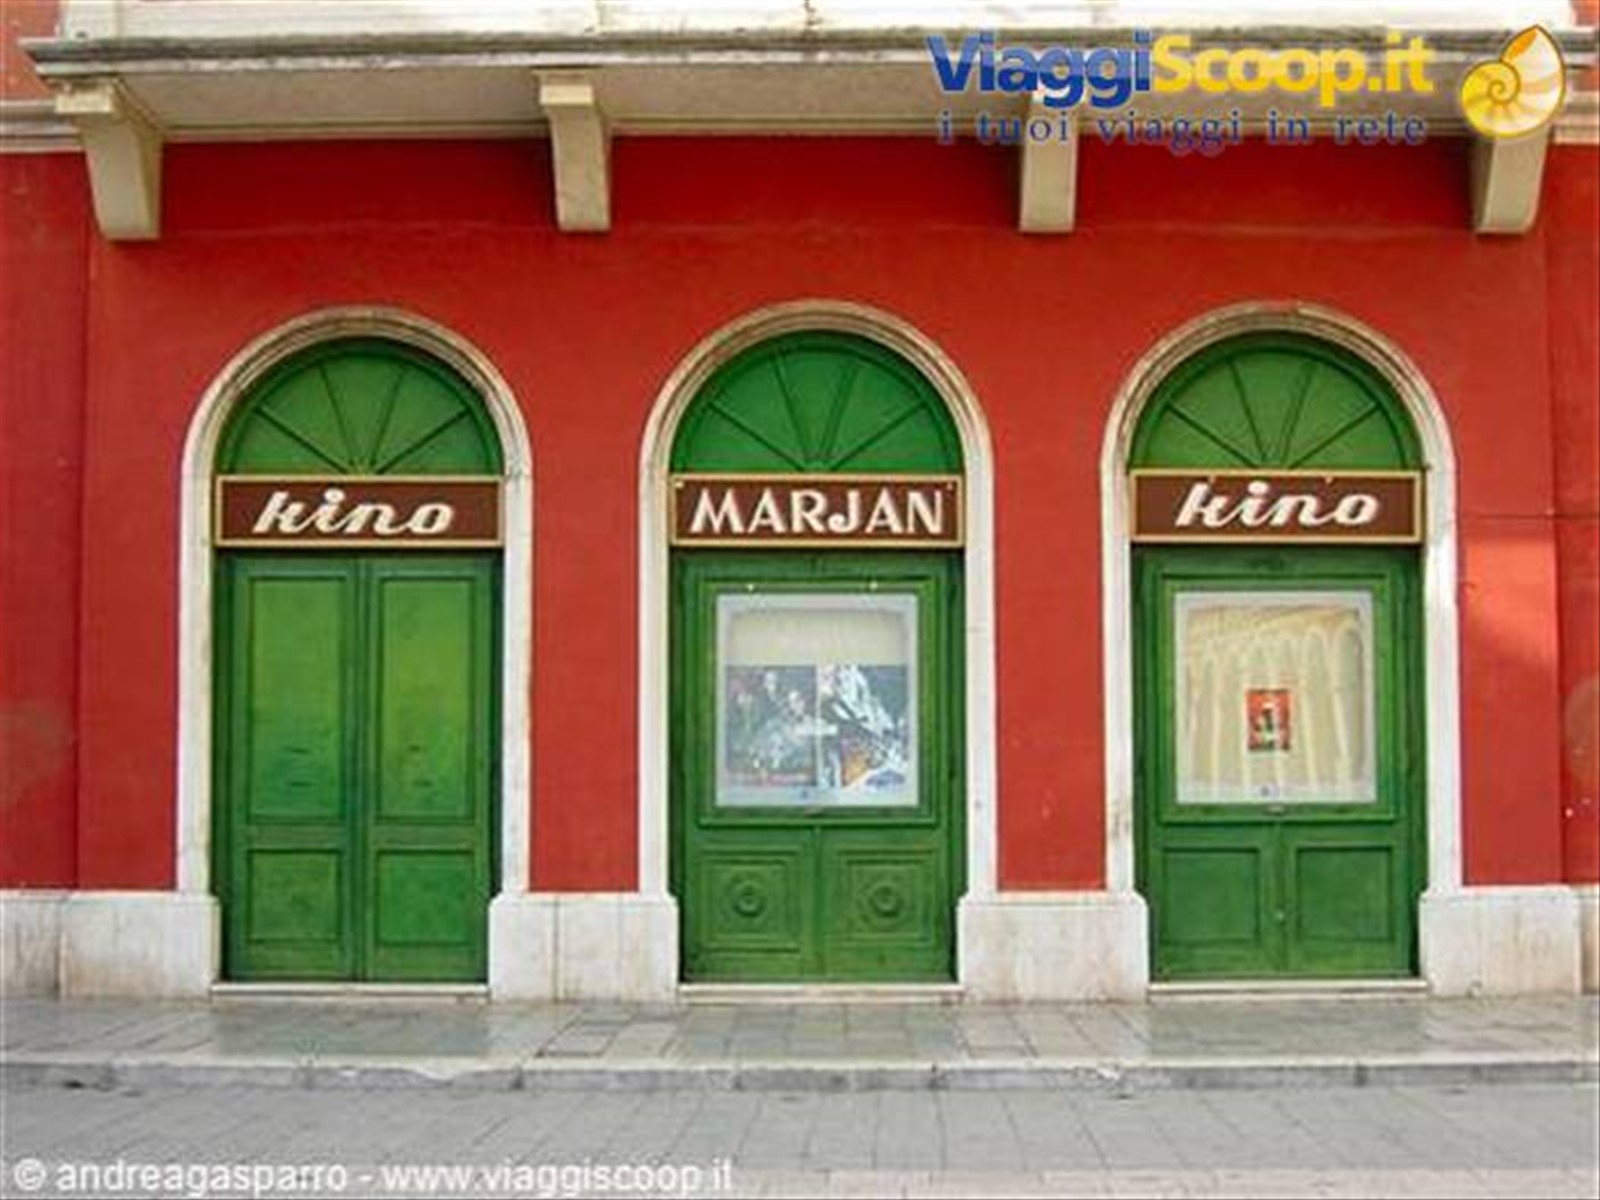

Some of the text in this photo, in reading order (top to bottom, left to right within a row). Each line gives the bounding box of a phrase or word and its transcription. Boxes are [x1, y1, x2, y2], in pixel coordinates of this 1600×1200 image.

[253, 488, 454, 535] kino
[690, 488, 943, 535] MARJAN
[1174, 480, 1379, 528] kino
